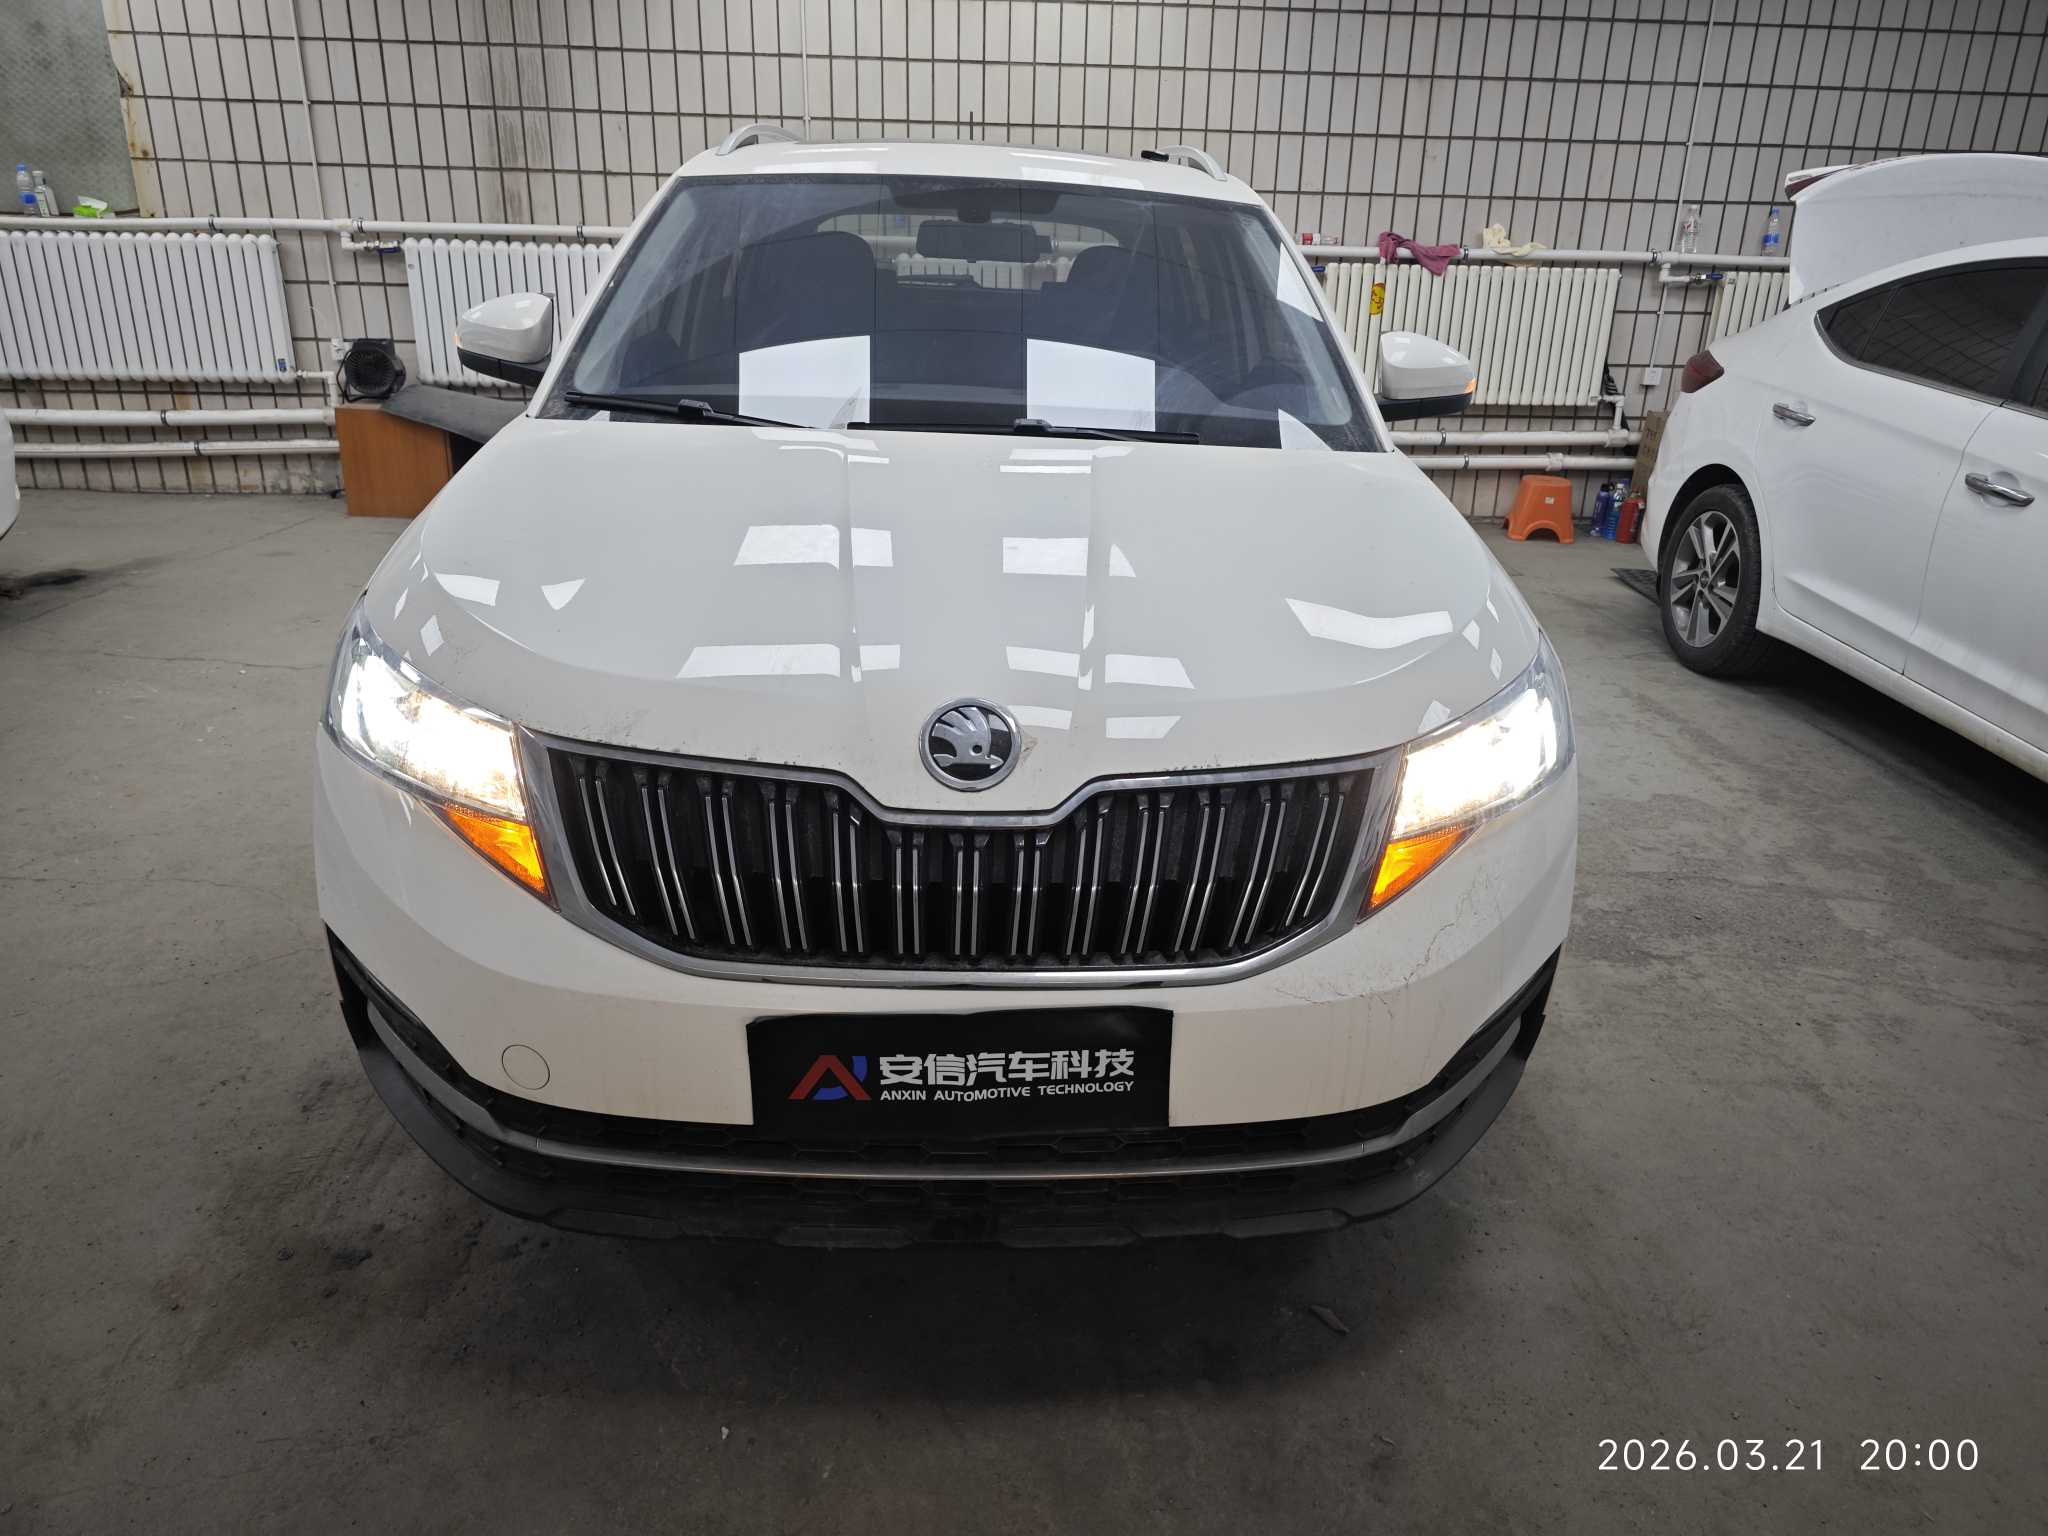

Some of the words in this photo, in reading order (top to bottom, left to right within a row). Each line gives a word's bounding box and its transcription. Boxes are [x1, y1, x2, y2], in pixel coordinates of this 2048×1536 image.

[879, 1048, 1135, 1086] 安信汽车科技
[879, 1089, 927, 1101] ANXIN
[933, 1086, 1031, 1102] AUTOMOTIVE
[1037, 1080, 1135, 1096] TECHNOLOGY
